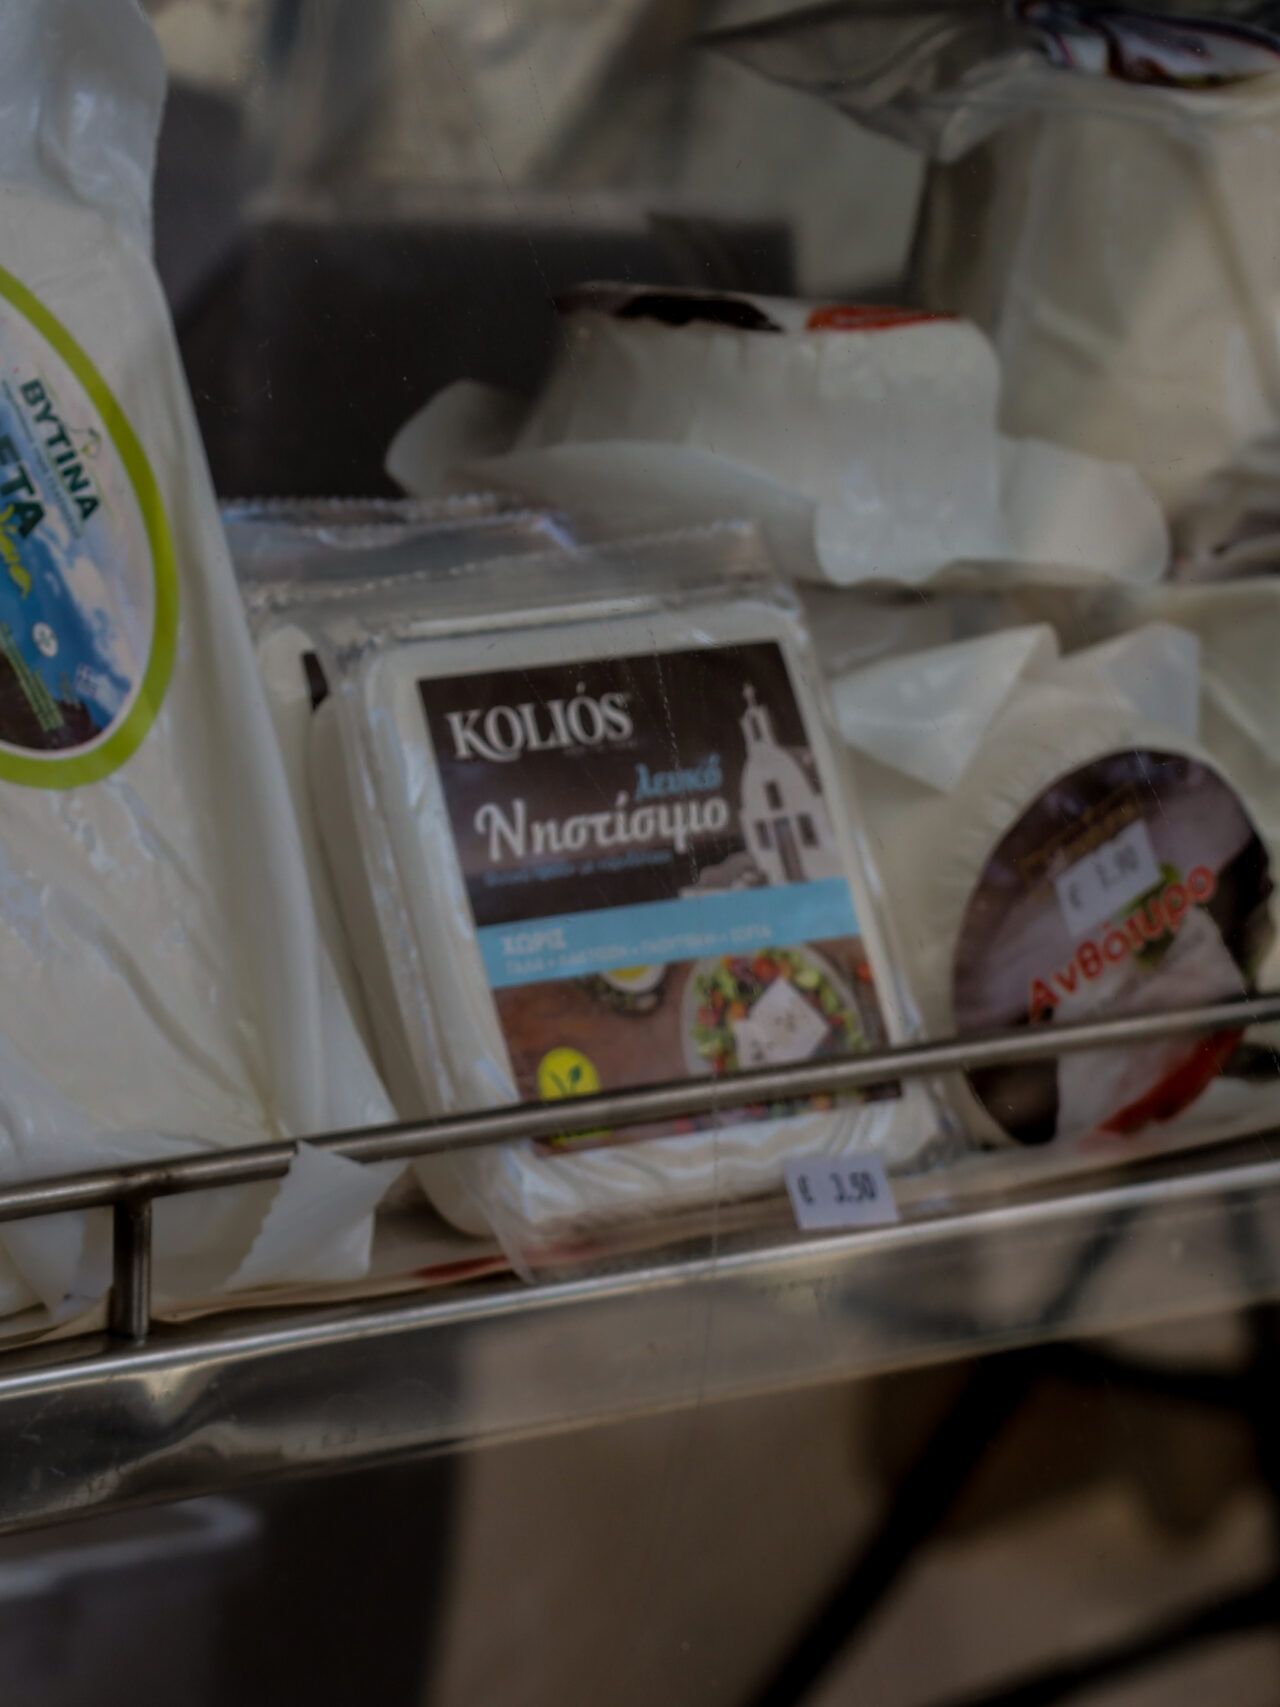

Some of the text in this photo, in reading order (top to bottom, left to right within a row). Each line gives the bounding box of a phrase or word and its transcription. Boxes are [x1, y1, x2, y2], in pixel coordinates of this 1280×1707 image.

[21, 379, 98, 518] BYTINA
[634, 753, 723, 801] λευκό
[473, 791, 729, 863] Νηστίσιμο
